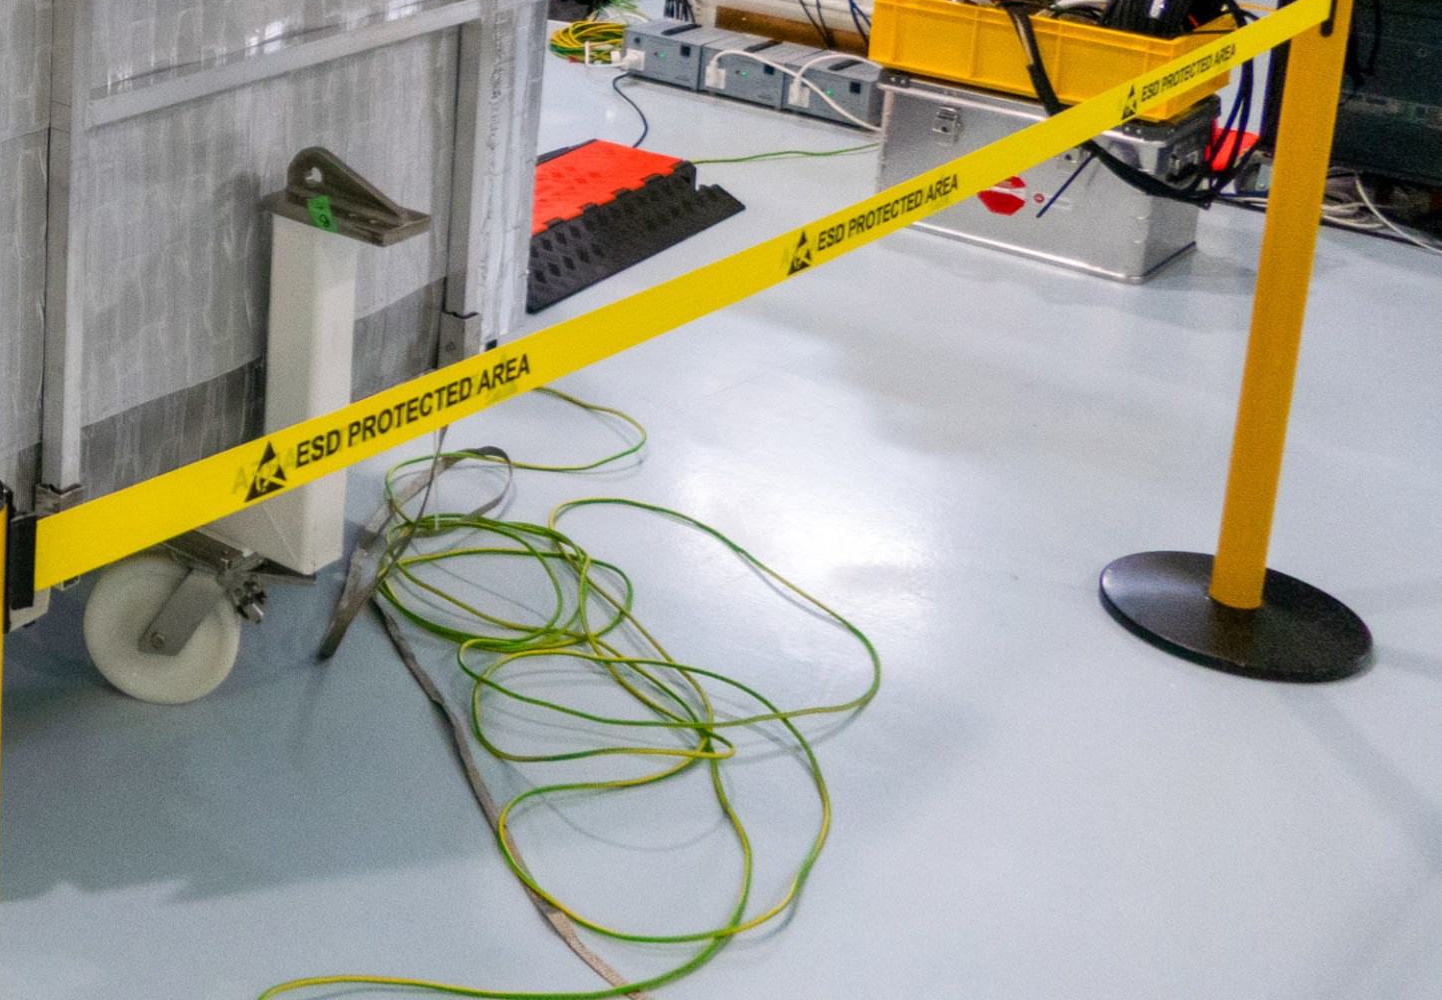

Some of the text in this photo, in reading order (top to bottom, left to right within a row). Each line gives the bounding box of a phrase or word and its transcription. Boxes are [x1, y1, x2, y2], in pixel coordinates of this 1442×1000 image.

[1141, 43, 1236, 102] ESD PROTECTED AREA
[817, 173, 958, 251] ESD PROTECTED AREA
[296, 353, 530, 468] ESD PROTECTED AREA
